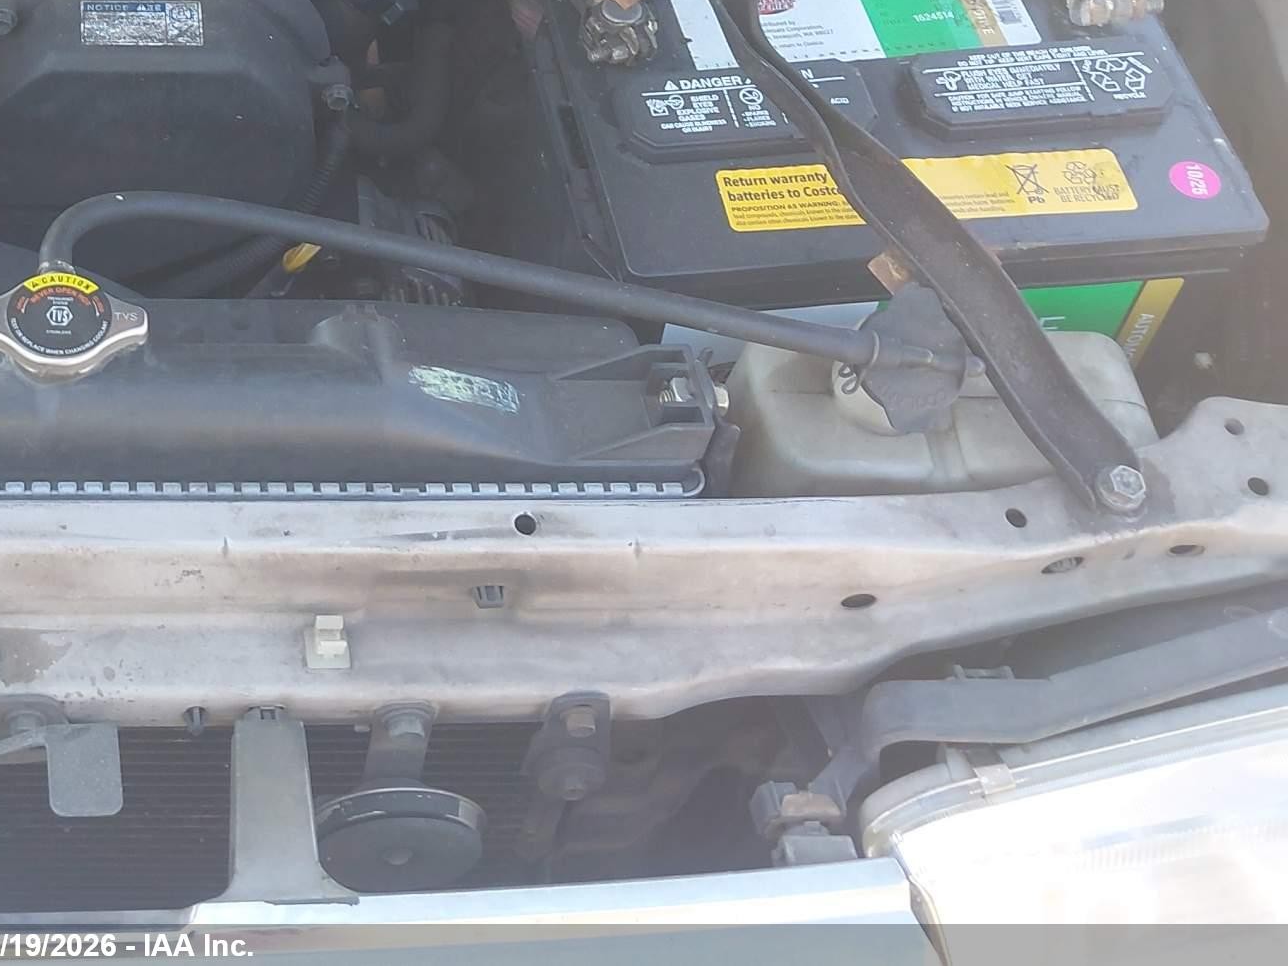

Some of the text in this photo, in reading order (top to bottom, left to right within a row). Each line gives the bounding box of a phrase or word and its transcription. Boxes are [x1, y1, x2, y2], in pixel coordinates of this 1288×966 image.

[679, 76, 743, 90] DANGER
[723, 172, 828, 188] Return warranty
[727, 188, 785, 202] batteries
[788, 188, 801, 199] to
[1053, 184, 1121, 196] BATTERY MUST
[1028, 195, 1046, 204] Pb
[1061, 192, 1121, 203] BE RECYCLED
[732, 203, 786, 212] PROPOSITION
[41, 275, 91, 291] CAUTION
[52, 310, 69, 323] TVS
[114, 312, 139, 322] TVS
[21, 334, 45, 353] REPLACE
[64, 339, 95, 355] CHANGING
[93, 320, 108, 343] COOLANT
